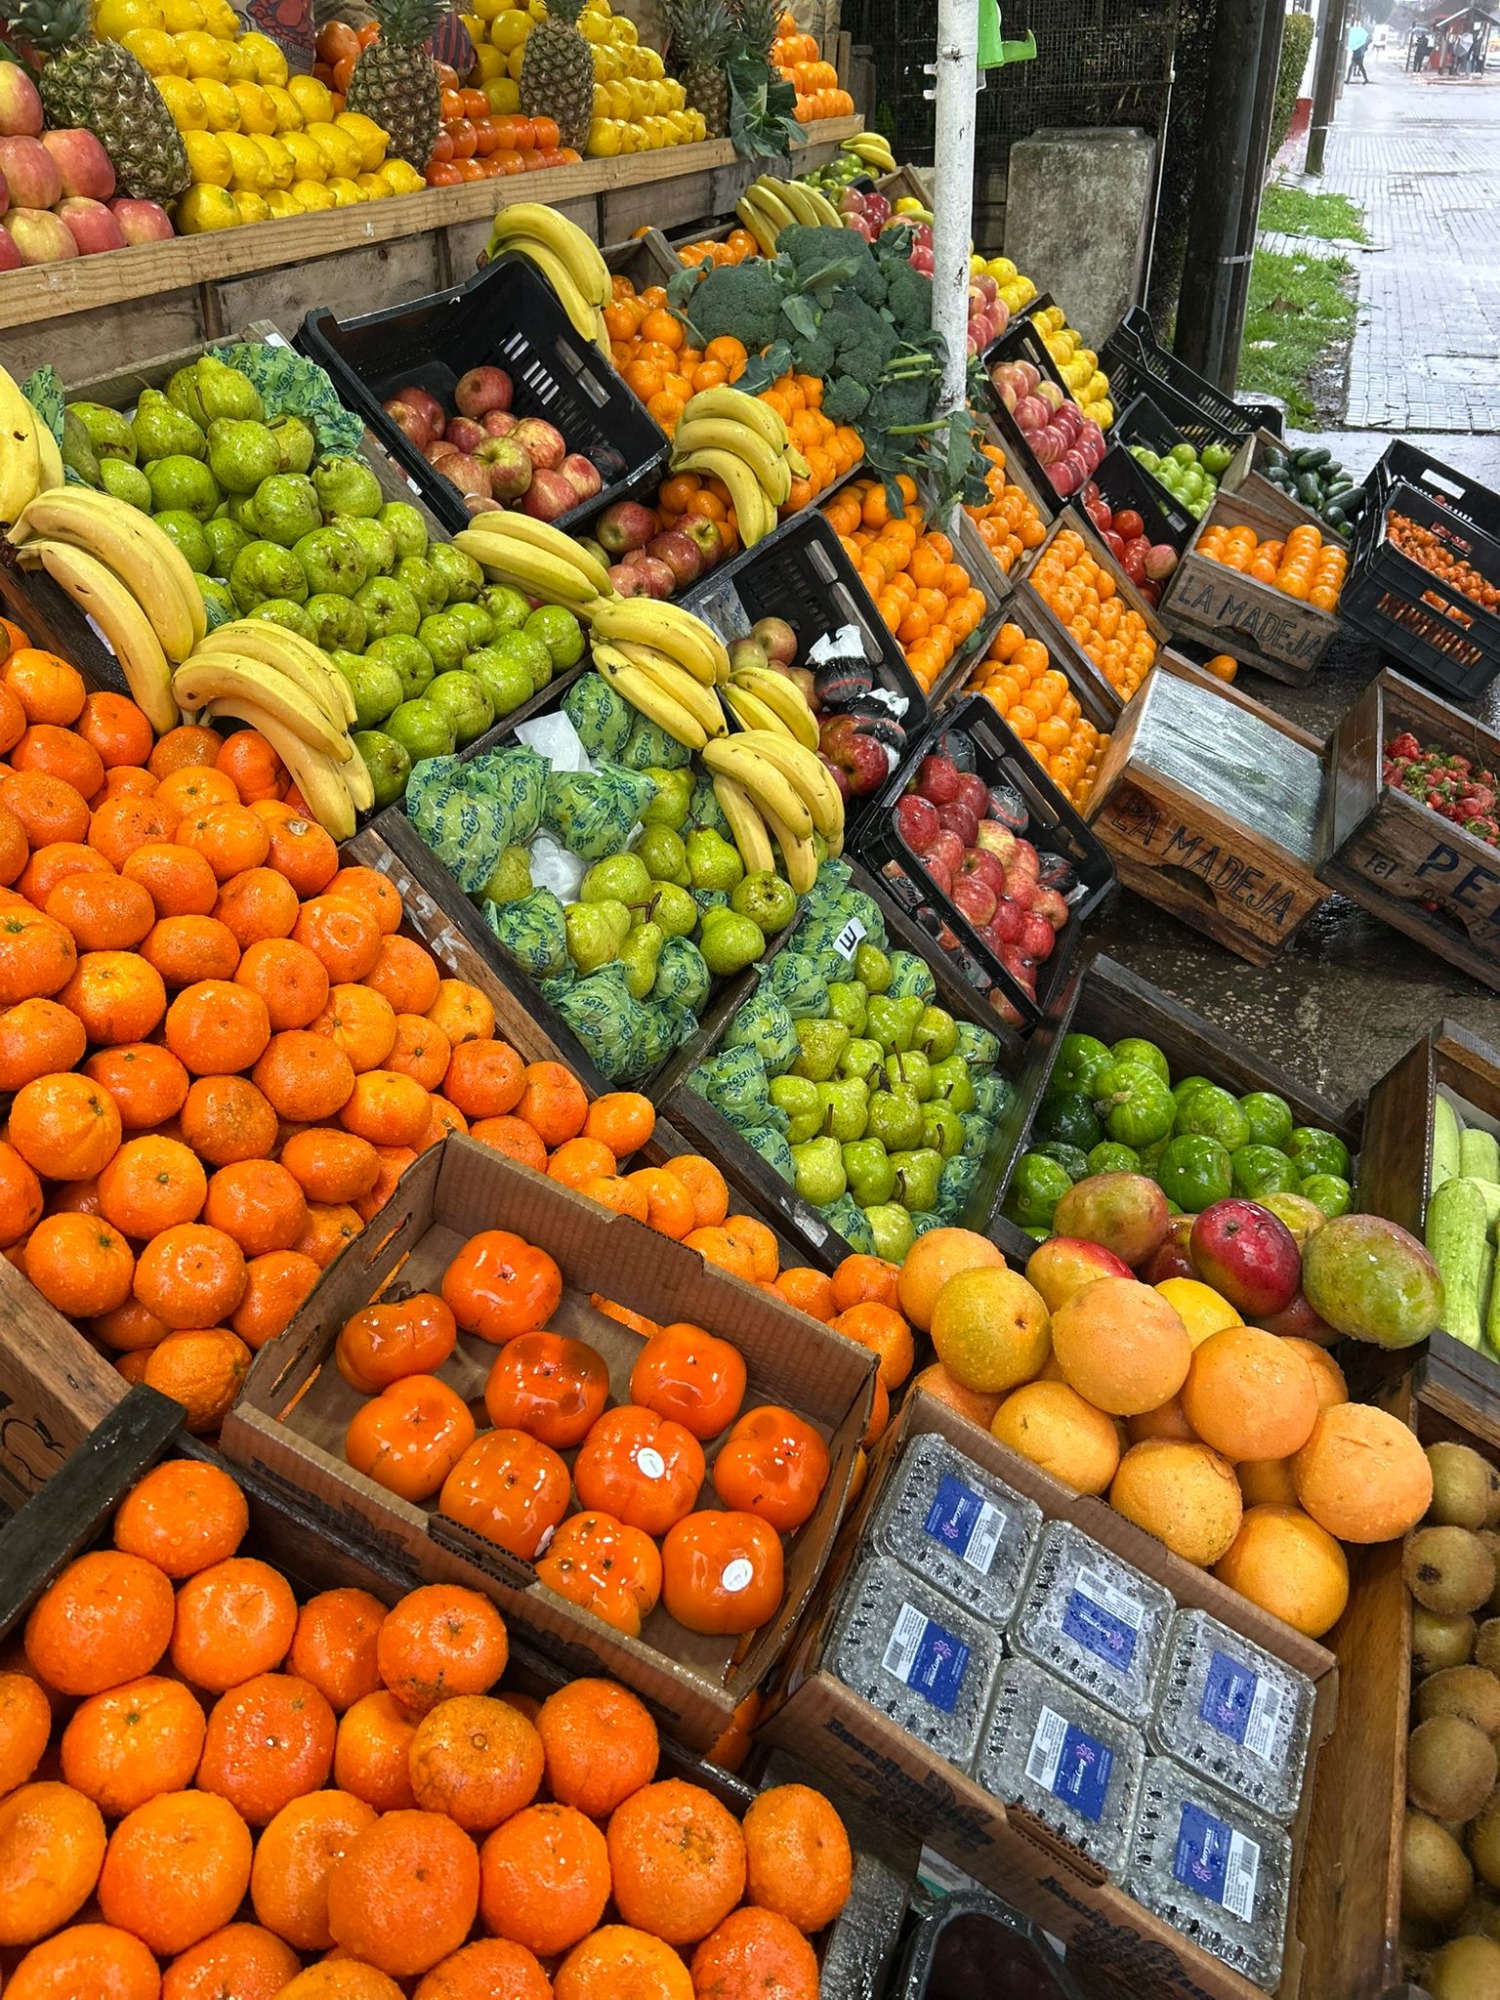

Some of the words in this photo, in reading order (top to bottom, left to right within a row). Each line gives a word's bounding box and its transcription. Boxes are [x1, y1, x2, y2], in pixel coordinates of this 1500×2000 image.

[1177, 575, 1215, 615] LA
[1216, 594, 1322, 662] MADEJA
[1111, 793, 1163, 847] LA
[1161, 824, 1296, 928] MADEJA
[1414, 842, 1500, 926] PE
[950, 1497, 966, 1527] Berrymax
[1079, 1612, 1111, 1638] Berrymax
[927, 1653, 943, 1688] Berrymax
[1225, 1674, 1239, 1709] Berrymax
[1073, 1758, 1087, 1795] Berrymax
[1200, 1827, 1212, 1867] Berrymax
